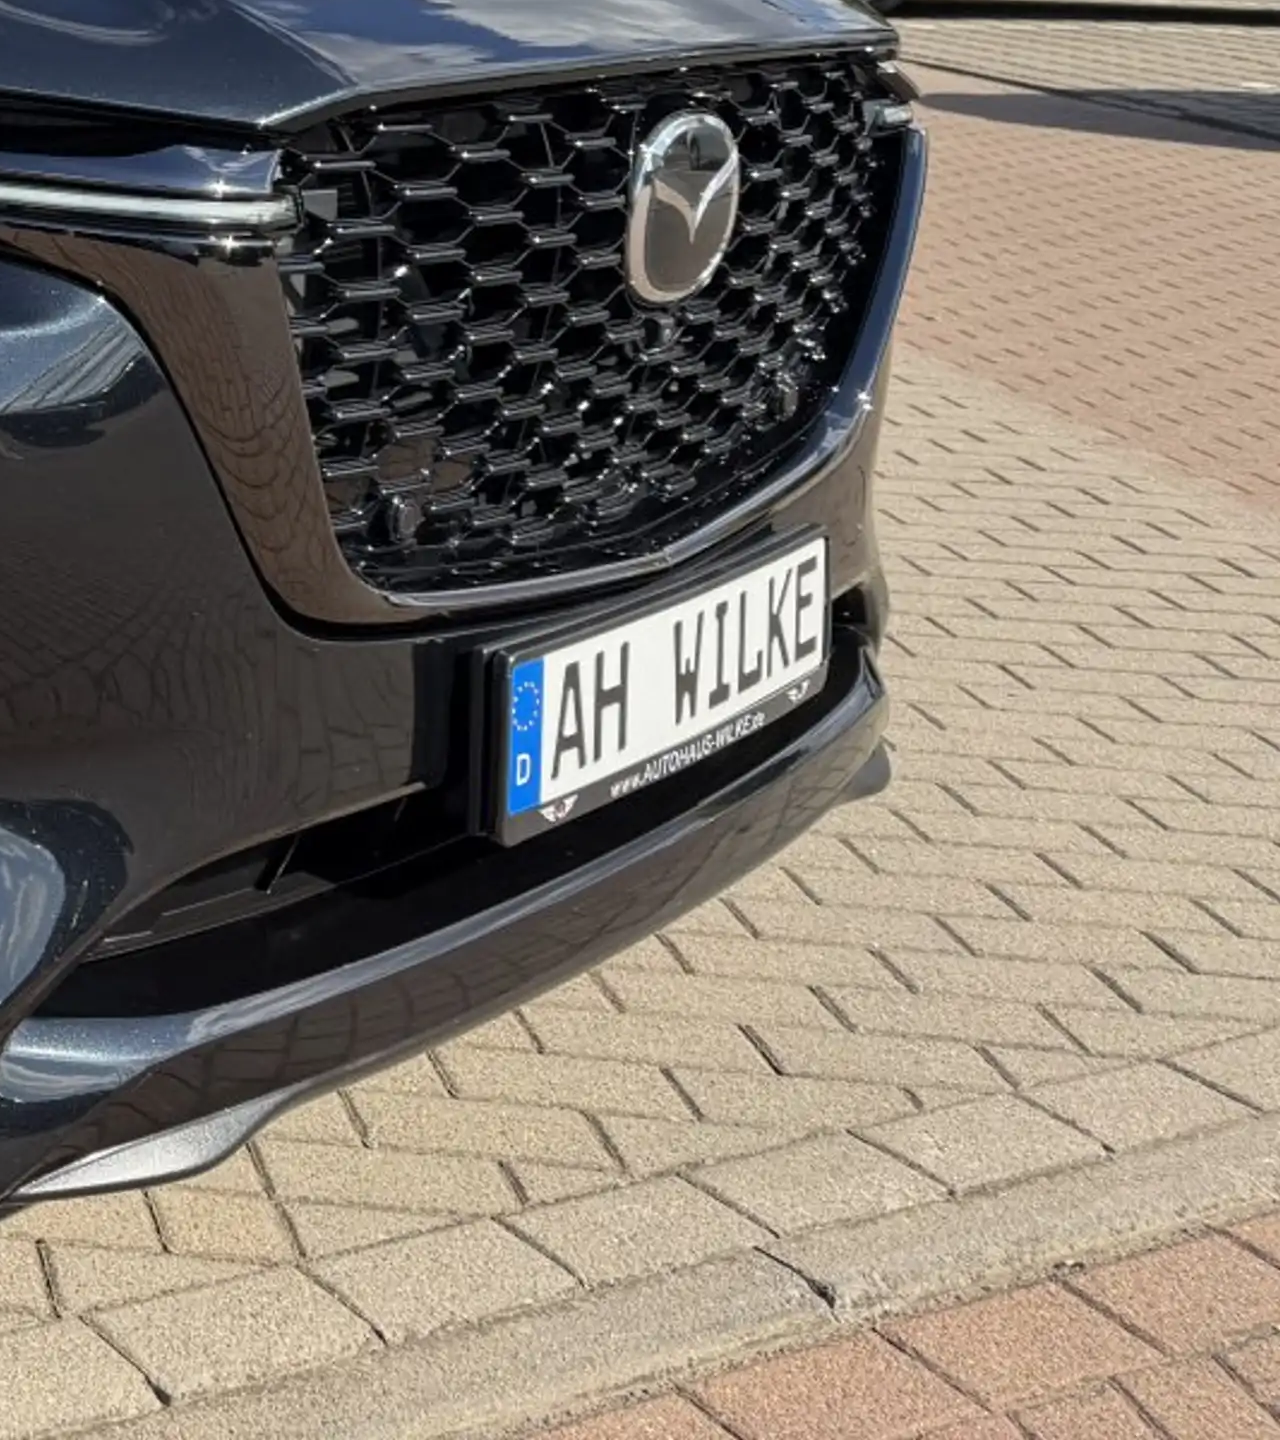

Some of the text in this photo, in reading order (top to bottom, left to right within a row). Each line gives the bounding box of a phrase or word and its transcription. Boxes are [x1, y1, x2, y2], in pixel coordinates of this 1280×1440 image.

[550, 556, 818, 781] AH WILKE
[516, 753, 531, 786] D
